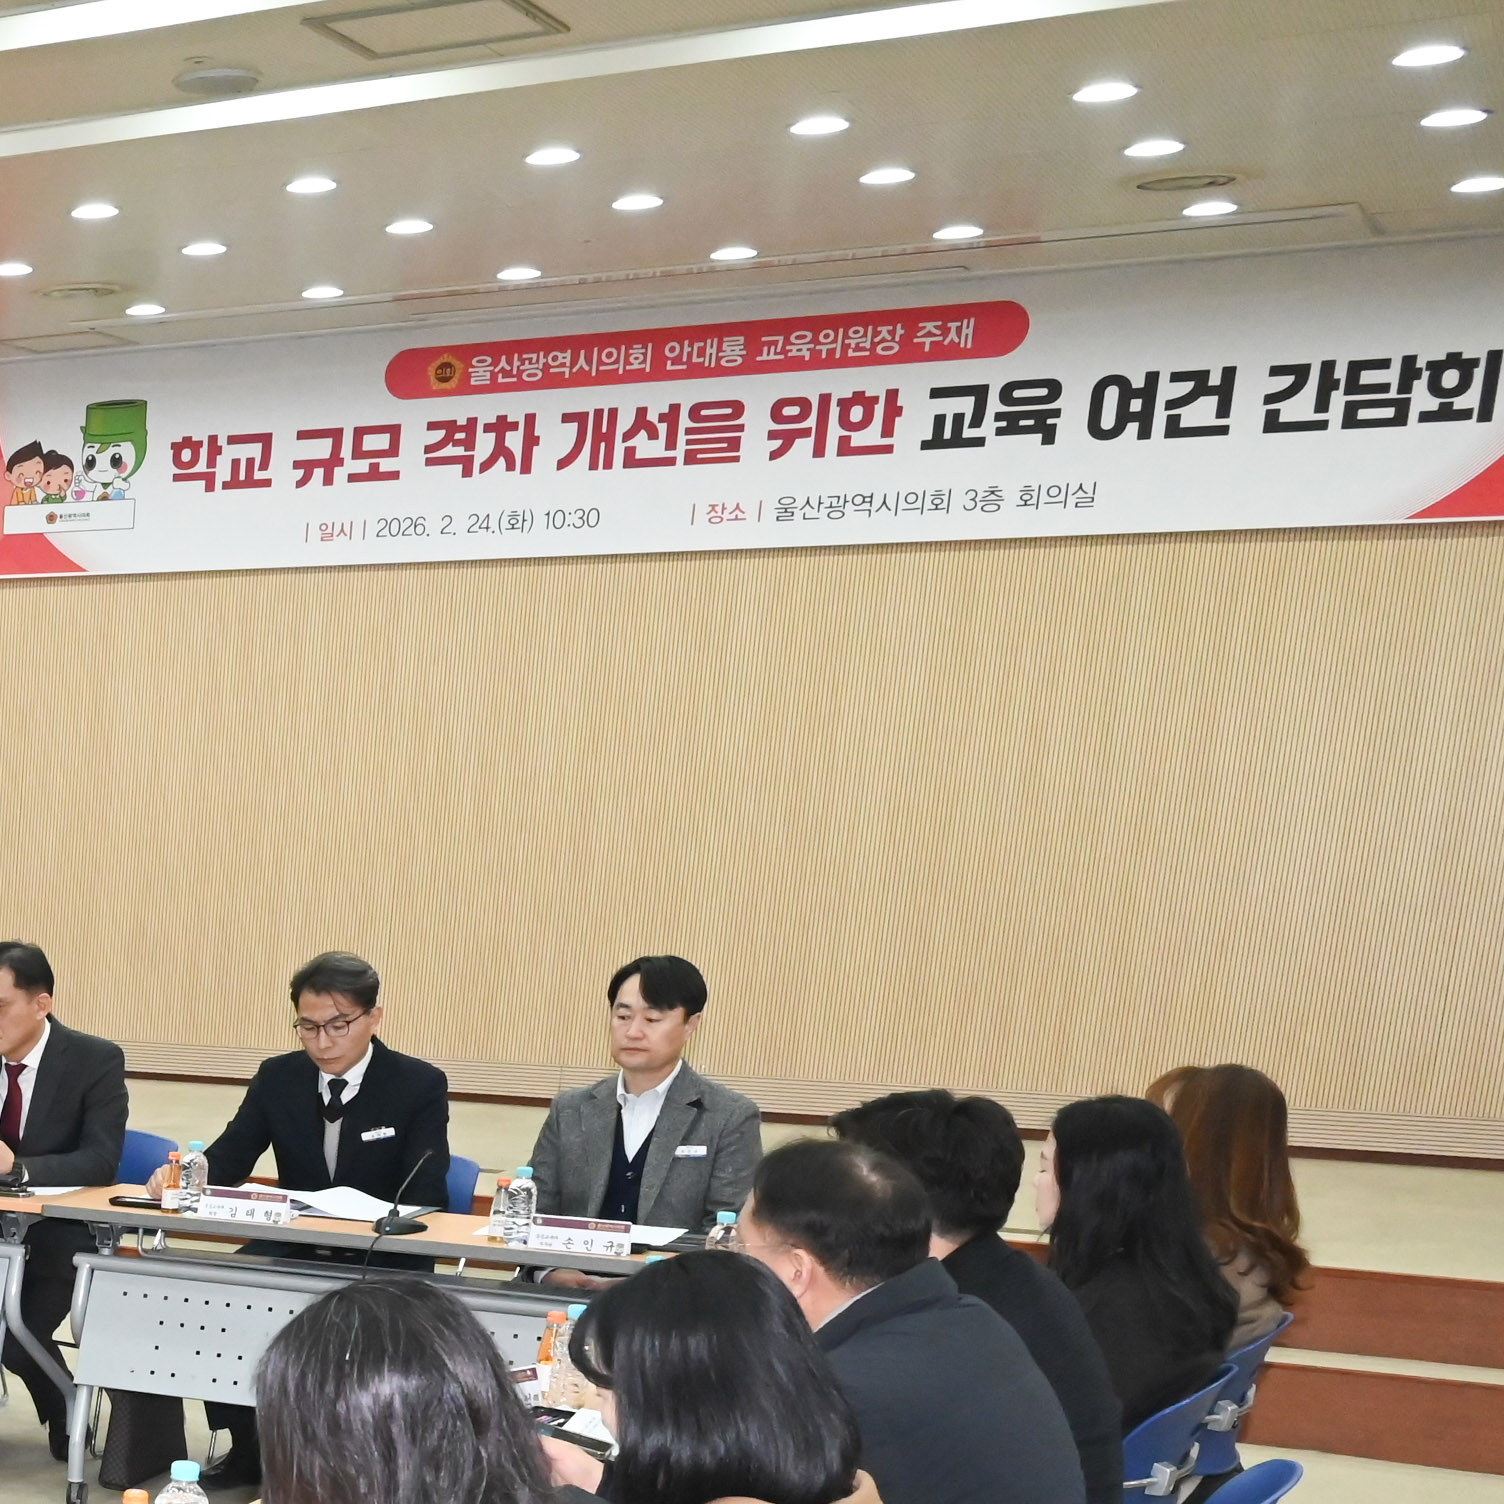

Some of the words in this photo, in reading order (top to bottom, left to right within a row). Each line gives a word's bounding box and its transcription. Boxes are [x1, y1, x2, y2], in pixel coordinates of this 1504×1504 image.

[468, 340, 652, 386] 울산광역시의회
[665, 337, 746, 369] 안대룡
[756, 324, 904, 363] 교육위원장
[914, 318, 975, 352] 주재
[171, 432, 273, 493] 학교
[293, 423, 402, 489] 규모
[424, 413, 541, 479] 격차
[556, 399, 746, 472] 개선을
[767, 388, 904, 461] 위한
[920, 378, 1063, 452] 교육
[1087, 365, 1238, 441] 여건
[1261, 348, 1504, 434] 간담회
[317, 520, 355, 543] 일시
[376, 511, 434, 540] 2026.
[440, 512, 460, 538] 2.
[466, 506, 535, 538] 24.(화)
[543, 506, 602, 532] 10:30
[705, 502, 747, 525] 장소
[774, 487, 952, 522] 울산광역시의회
[963, 484, 1005, 514] 3층
[1016, 481, 1099, 512] 회의실
